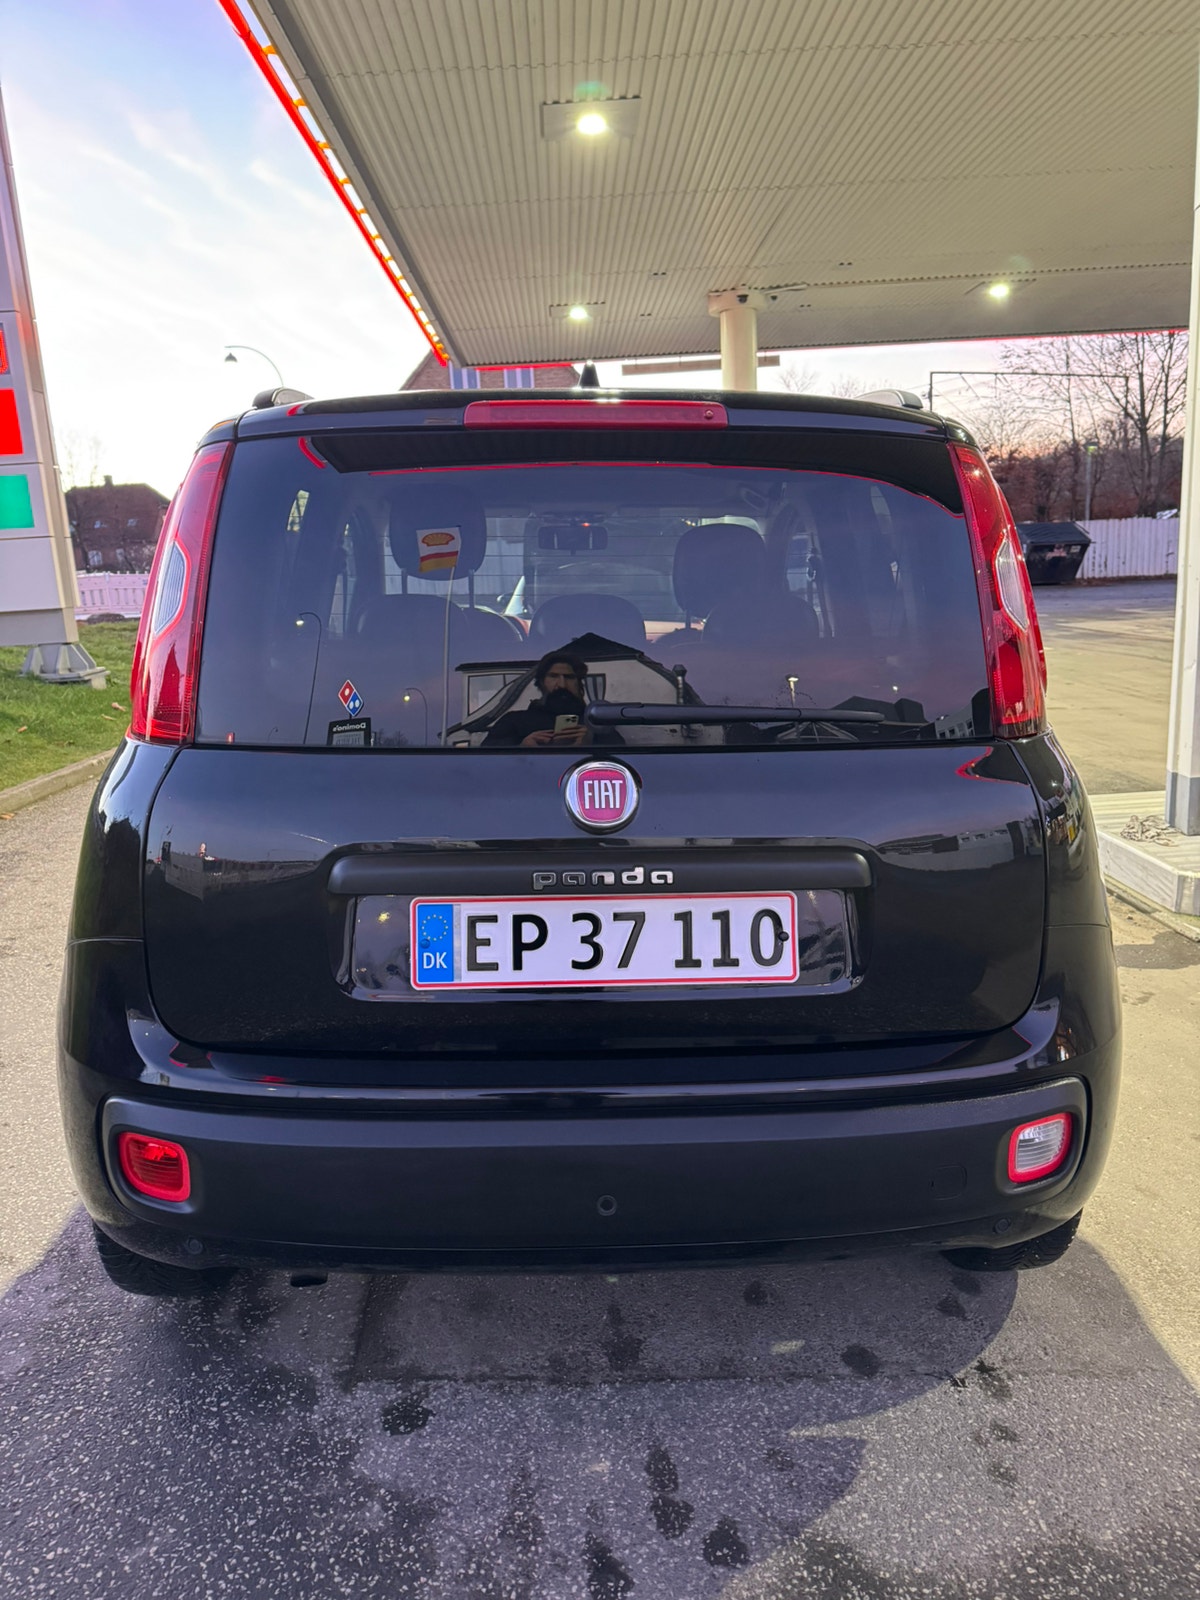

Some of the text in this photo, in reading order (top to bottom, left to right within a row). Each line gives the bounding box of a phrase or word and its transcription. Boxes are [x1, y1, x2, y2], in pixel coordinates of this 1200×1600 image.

[584, 780, 623, 809] FIAT
[533, 866, 673, 890] panda
[467, 908, 785, 971] EP 37 110
[423, 952, 448, 969] DK
